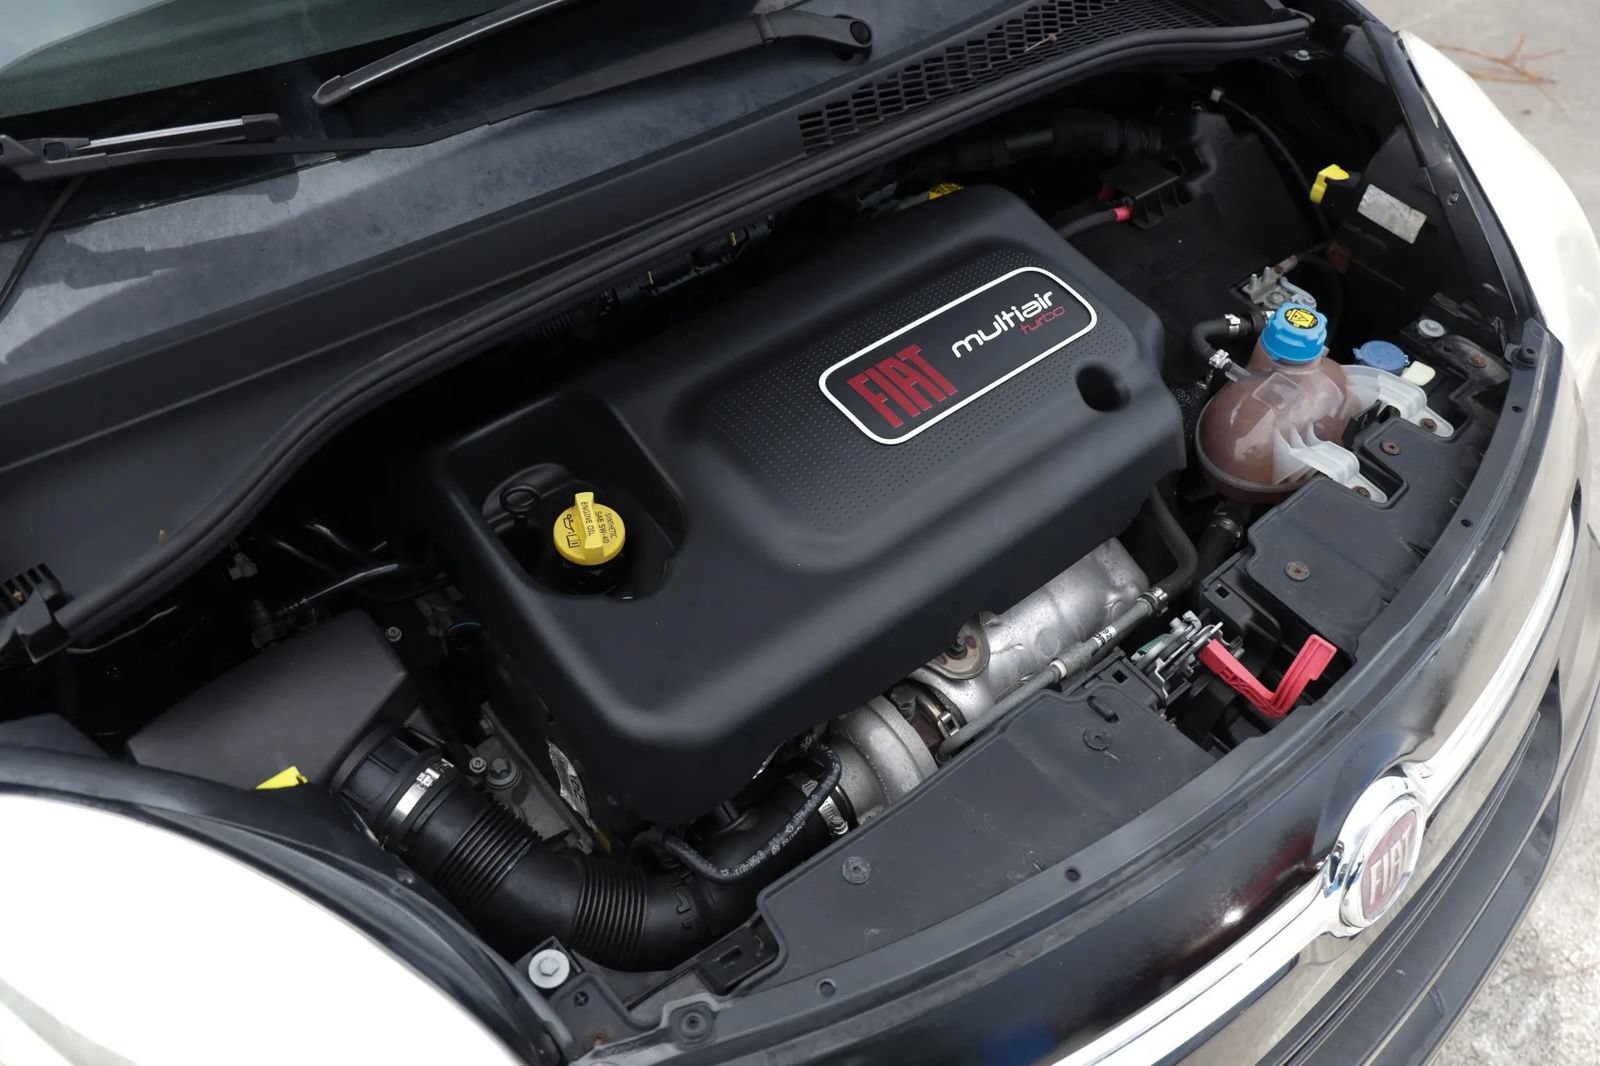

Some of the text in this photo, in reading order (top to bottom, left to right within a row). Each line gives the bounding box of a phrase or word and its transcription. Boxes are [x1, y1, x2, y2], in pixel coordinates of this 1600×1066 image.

[951, 291, 1054, 359] multiair
[1019, 305, 1065, 335] turbo
[846, 343, 959, 429] FIAT
[580, 501, 596, 537] ENGINE OIL
[595, 511, 610, 544] SAE 5W-40
[605, 512, 618, 540] SYNTHETIC
[1369, 823, 1413, 906] FIAT
